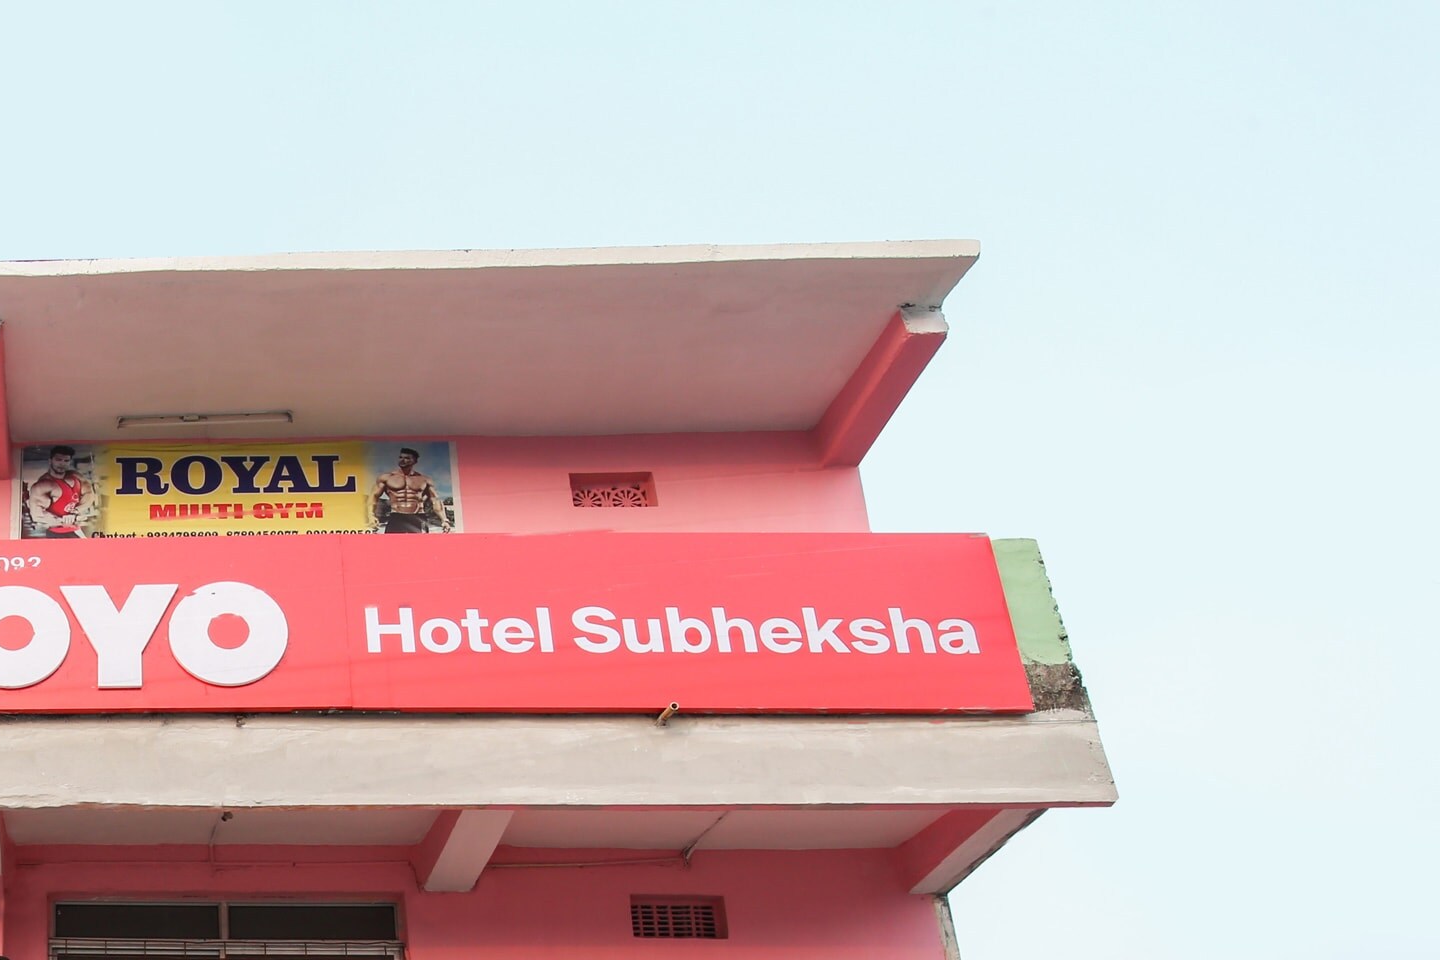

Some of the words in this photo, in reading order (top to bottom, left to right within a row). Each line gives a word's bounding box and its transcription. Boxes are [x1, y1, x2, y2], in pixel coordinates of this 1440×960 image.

[115, 455, 356, 495] ROYAL
[253, 502, 323, 519] GYM
[364, 607, 555, 654] Hotel
[572, 606, 982, 654] Subheksha
